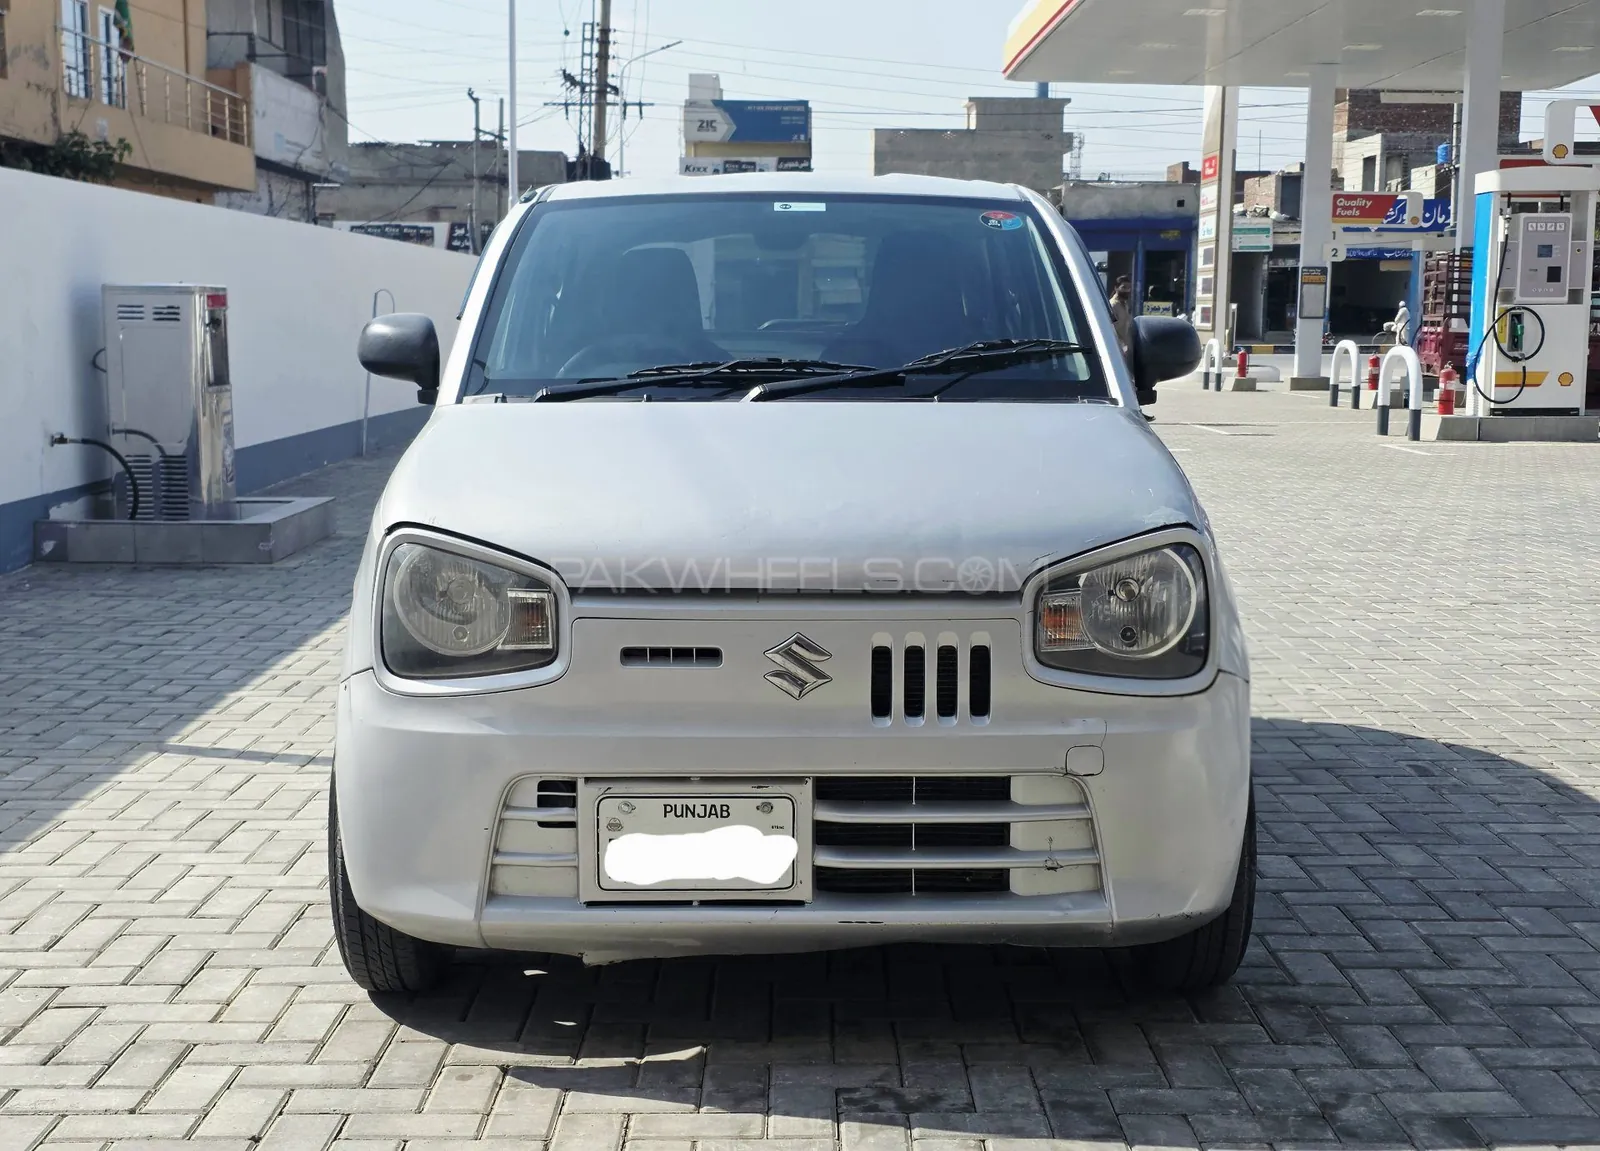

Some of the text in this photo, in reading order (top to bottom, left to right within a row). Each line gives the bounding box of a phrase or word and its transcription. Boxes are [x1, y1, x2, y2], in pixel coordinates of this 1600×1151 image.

[697, 119, 717, 128] ZIC
[684, 164, 709, 173] Kixx
[1336, 198, 1372, 208] Quality
[1336, 208, 1360, 216] Fuels
[1332, 231, 1336, 240] 1
[1331, 248, 1338, 257] 2
[663, 803, 731, 819] PUNJAB
